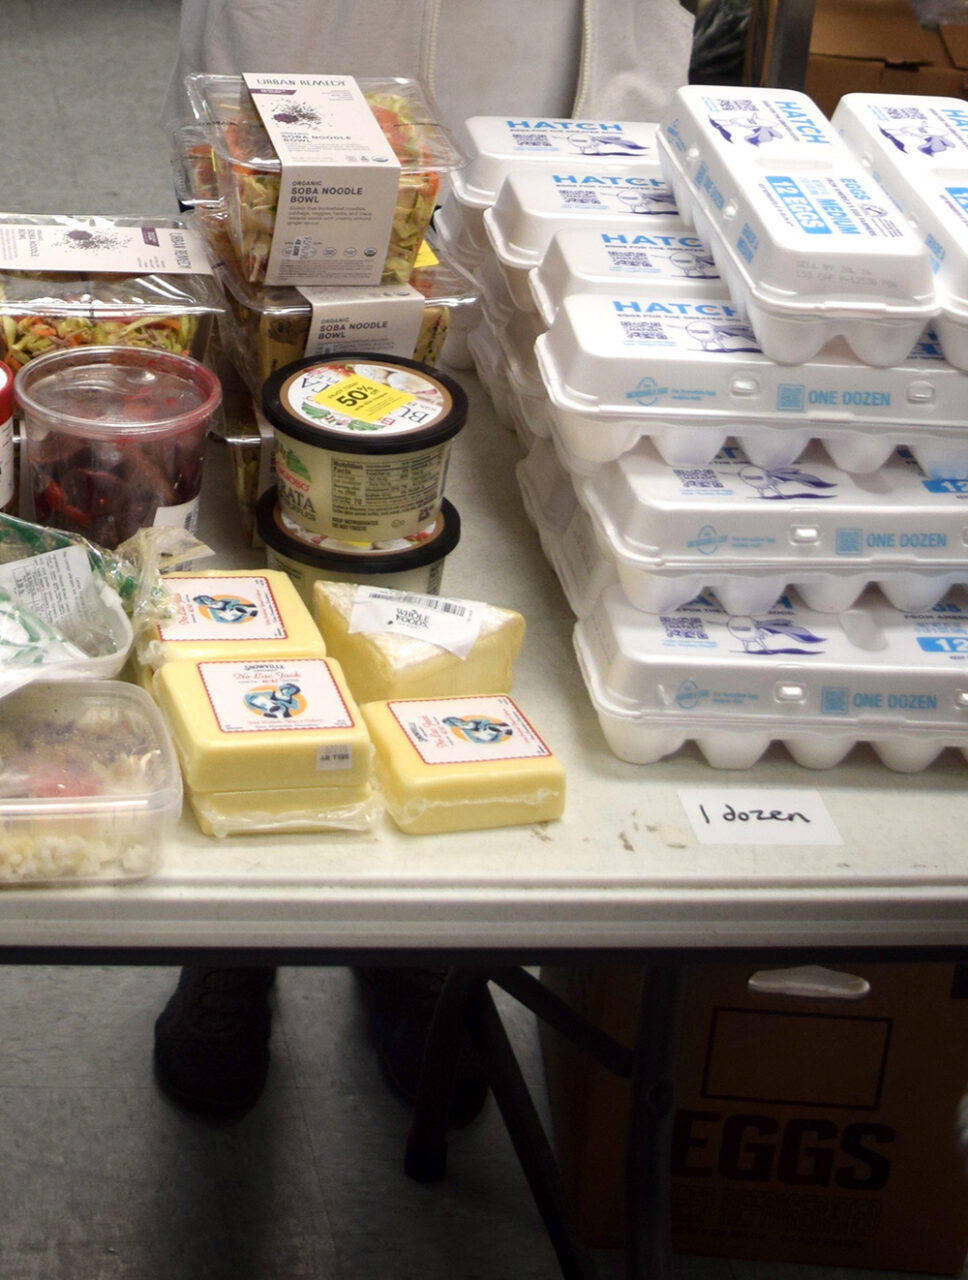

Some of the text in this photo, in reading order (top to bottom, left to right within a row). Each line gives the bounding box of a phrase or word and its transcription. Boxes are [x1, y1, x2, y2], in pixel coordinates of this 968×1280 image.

[256, 78, 346, 87] URBAN REMEDY
[506, 120, 623, 132] HATCH
[774, 100, 831, 145] HATCH
[290, 195, 320, 203] BOWL
[291, 187, 364, 195] SOBA NOODLE
[772, 180, 795, 195] 12
[785, 195, 821, 229] EGGS
[816, 197, 862, 235] MEDIUM
[601, 233, 703, 248] HATC
[319, 321, 389, 332] SOBA NOODLE
[318, 332, 347, 340] BOWL
[808, 390, 891, 407] ONE DOZEN
[866, 532, 947, 549] ONE DOZEN
[853, 692, 938, 709] ONE DOZEN
[722, 804, 811, 823] dozen
[671, 1108, 896, 1191] EGGS
